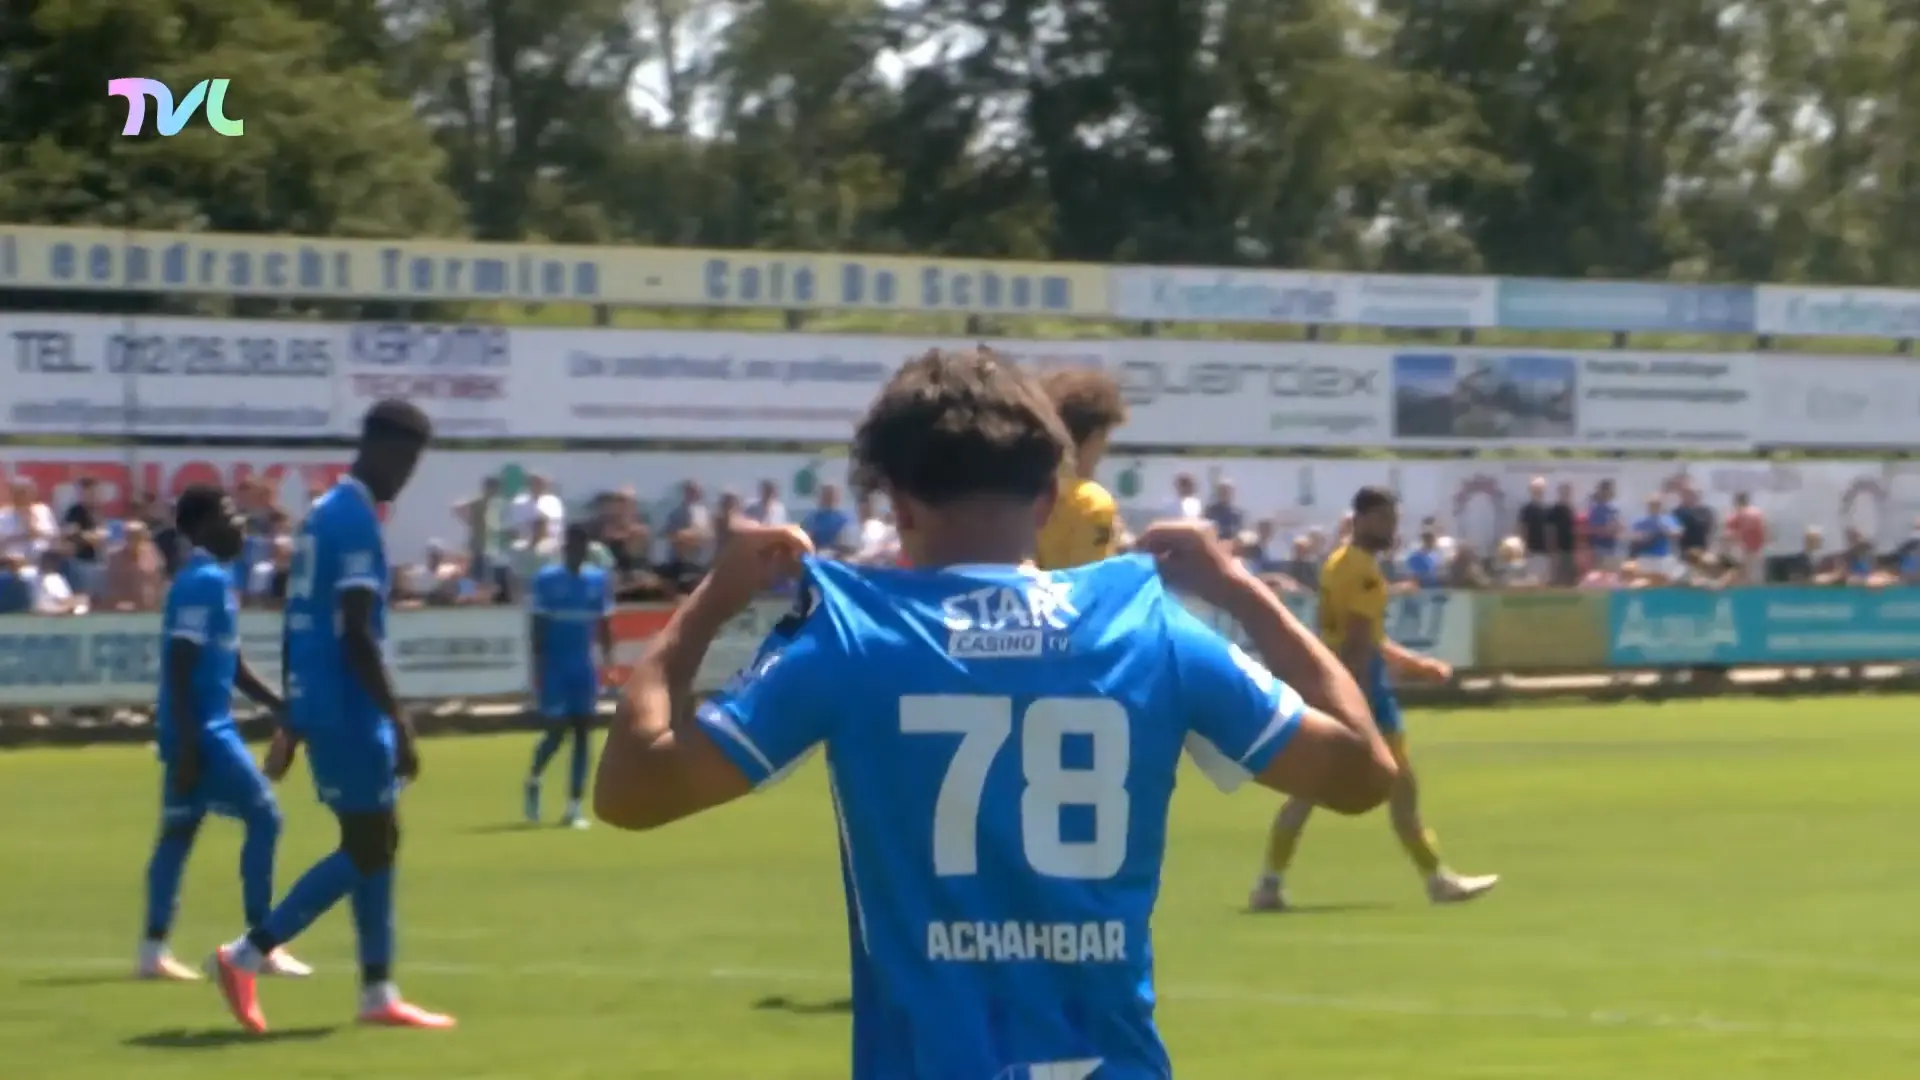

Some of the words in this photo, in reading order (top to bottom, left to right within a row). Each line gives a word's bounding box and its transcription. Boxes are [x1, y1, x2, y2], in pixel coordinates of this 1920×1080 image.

[956, 634, 1035, 652] CASINO
[900, 695, 1131, 880] 78
[927, 920, 1126, 962] ACHAHBAR
